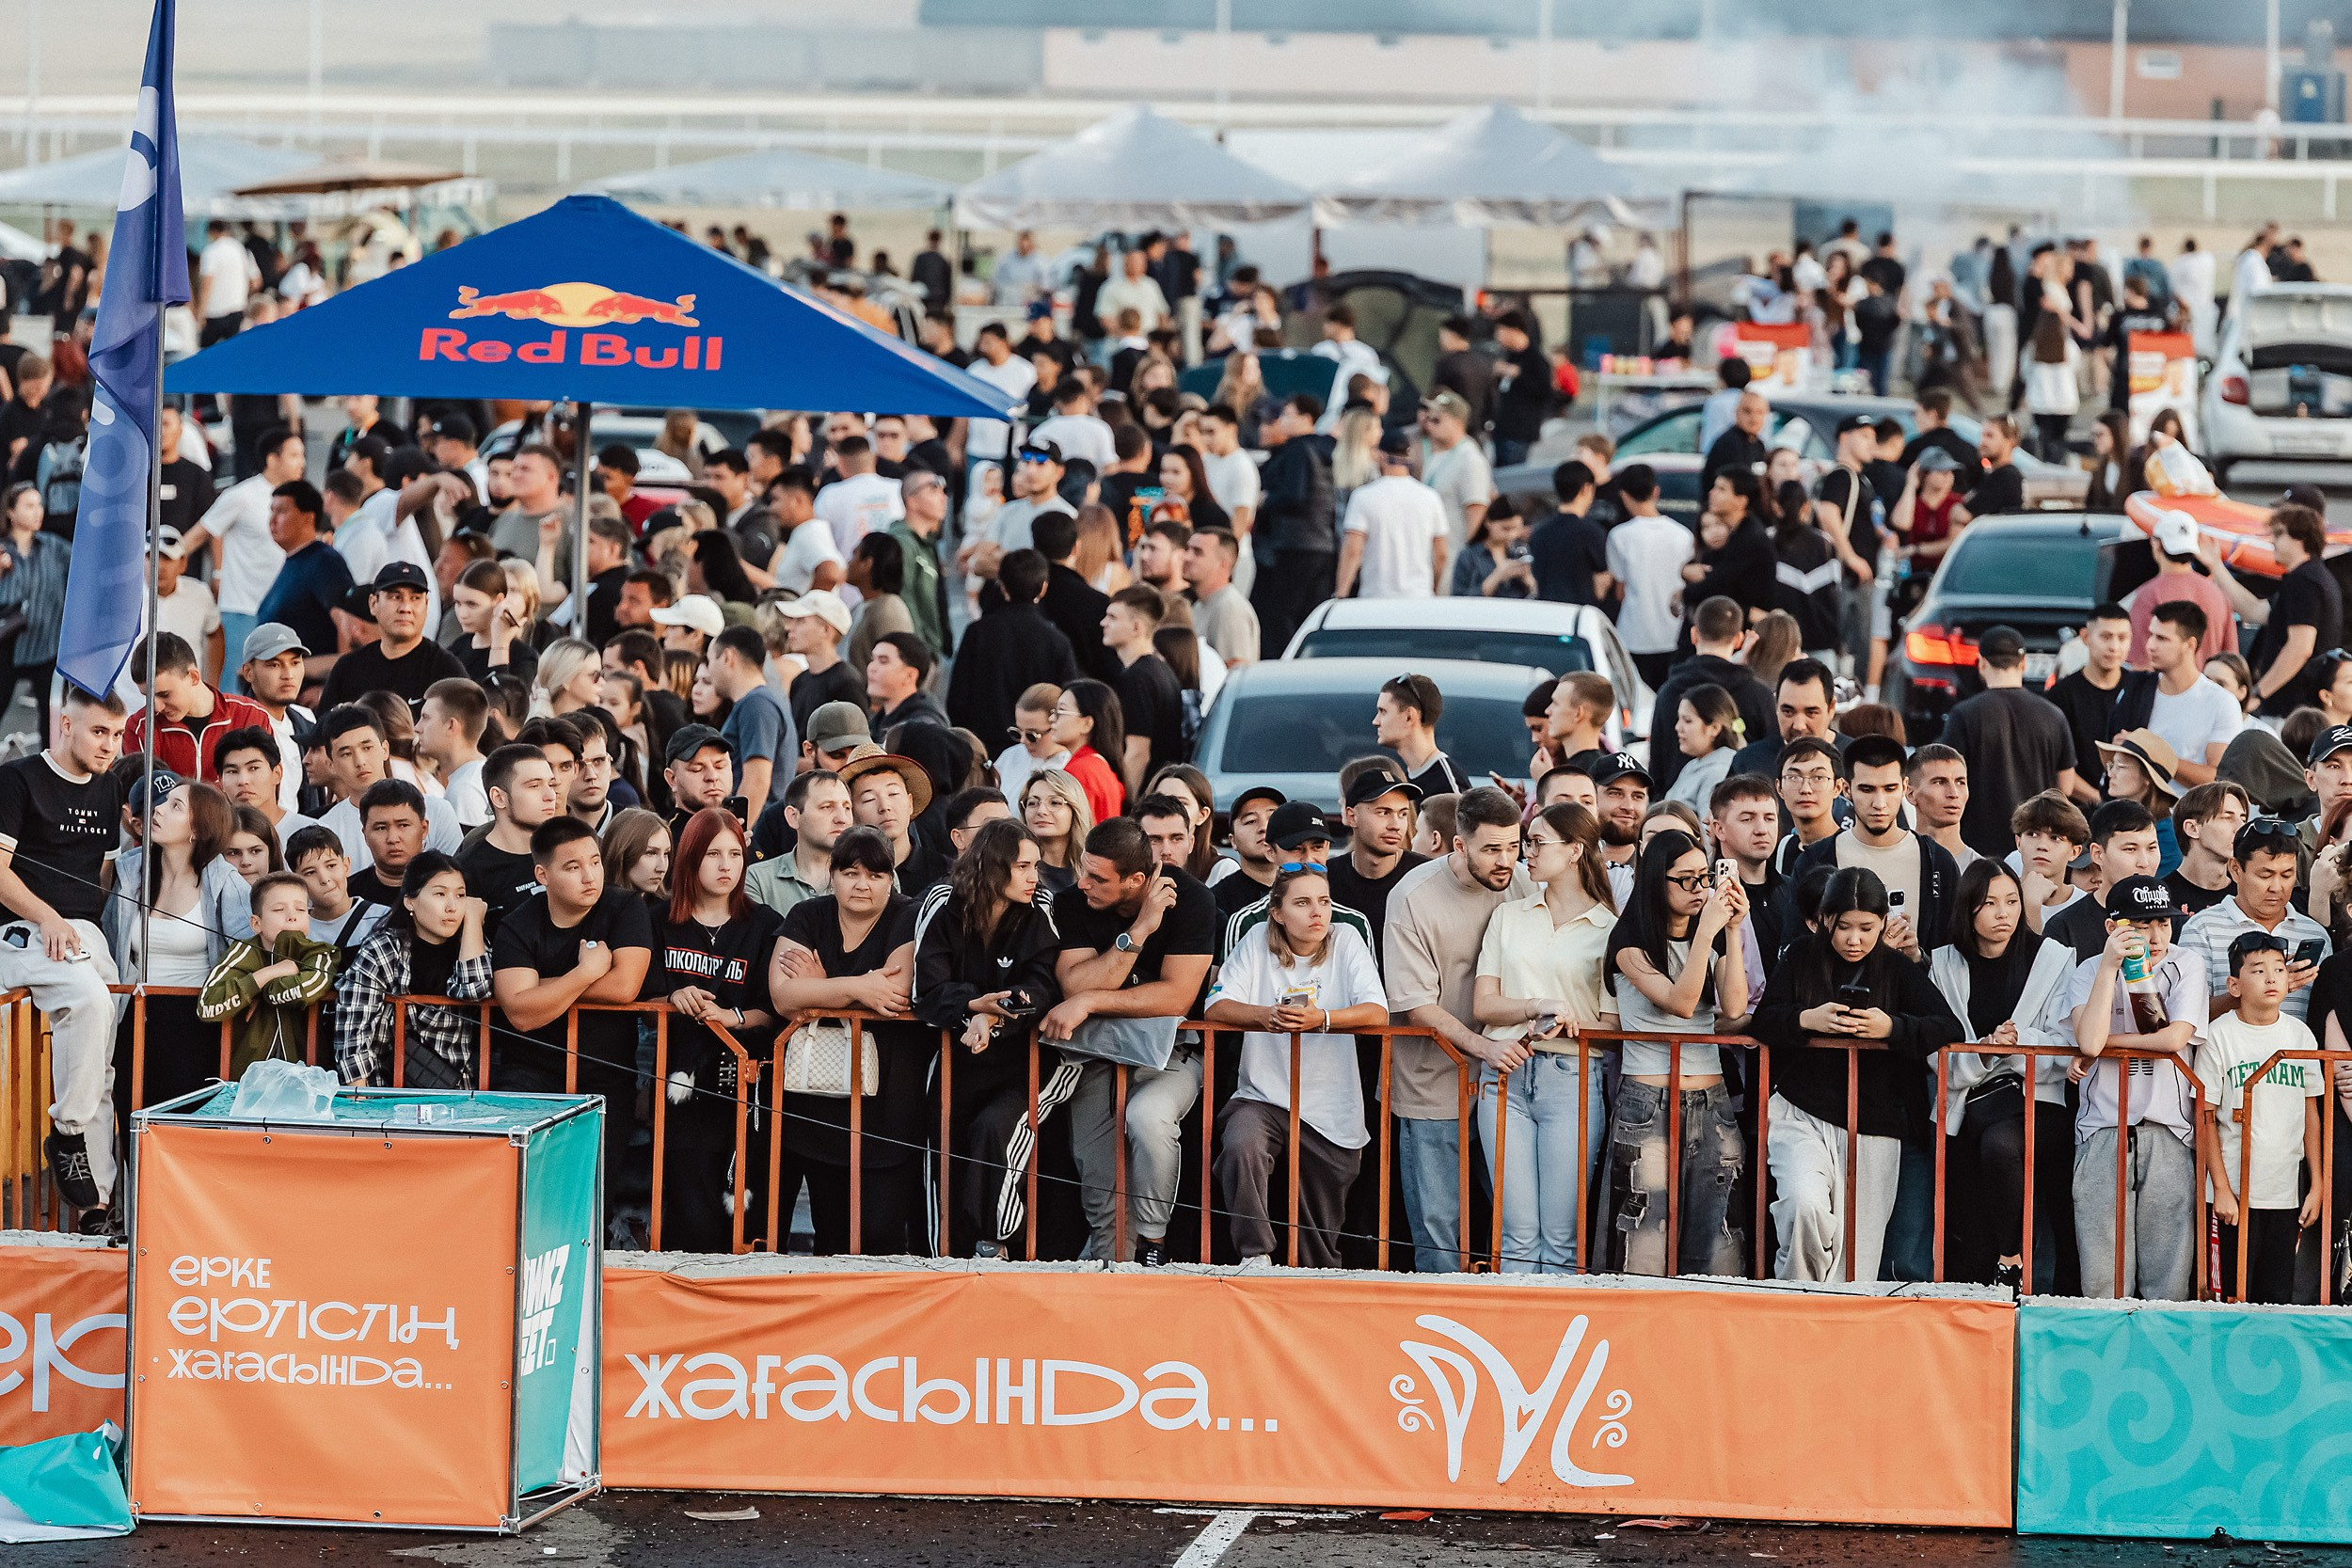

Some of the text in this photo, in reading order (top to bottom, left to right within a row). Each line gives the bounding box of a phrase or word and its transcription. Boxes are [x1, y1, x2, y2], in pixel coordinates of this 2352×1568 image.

[419, 327, 723, 371] Red Bull
[1616, 753, 1636, 769] NY
[68, 808, 98, 817] TOMMY
[59, 824, 107, 835] HILFIGER
